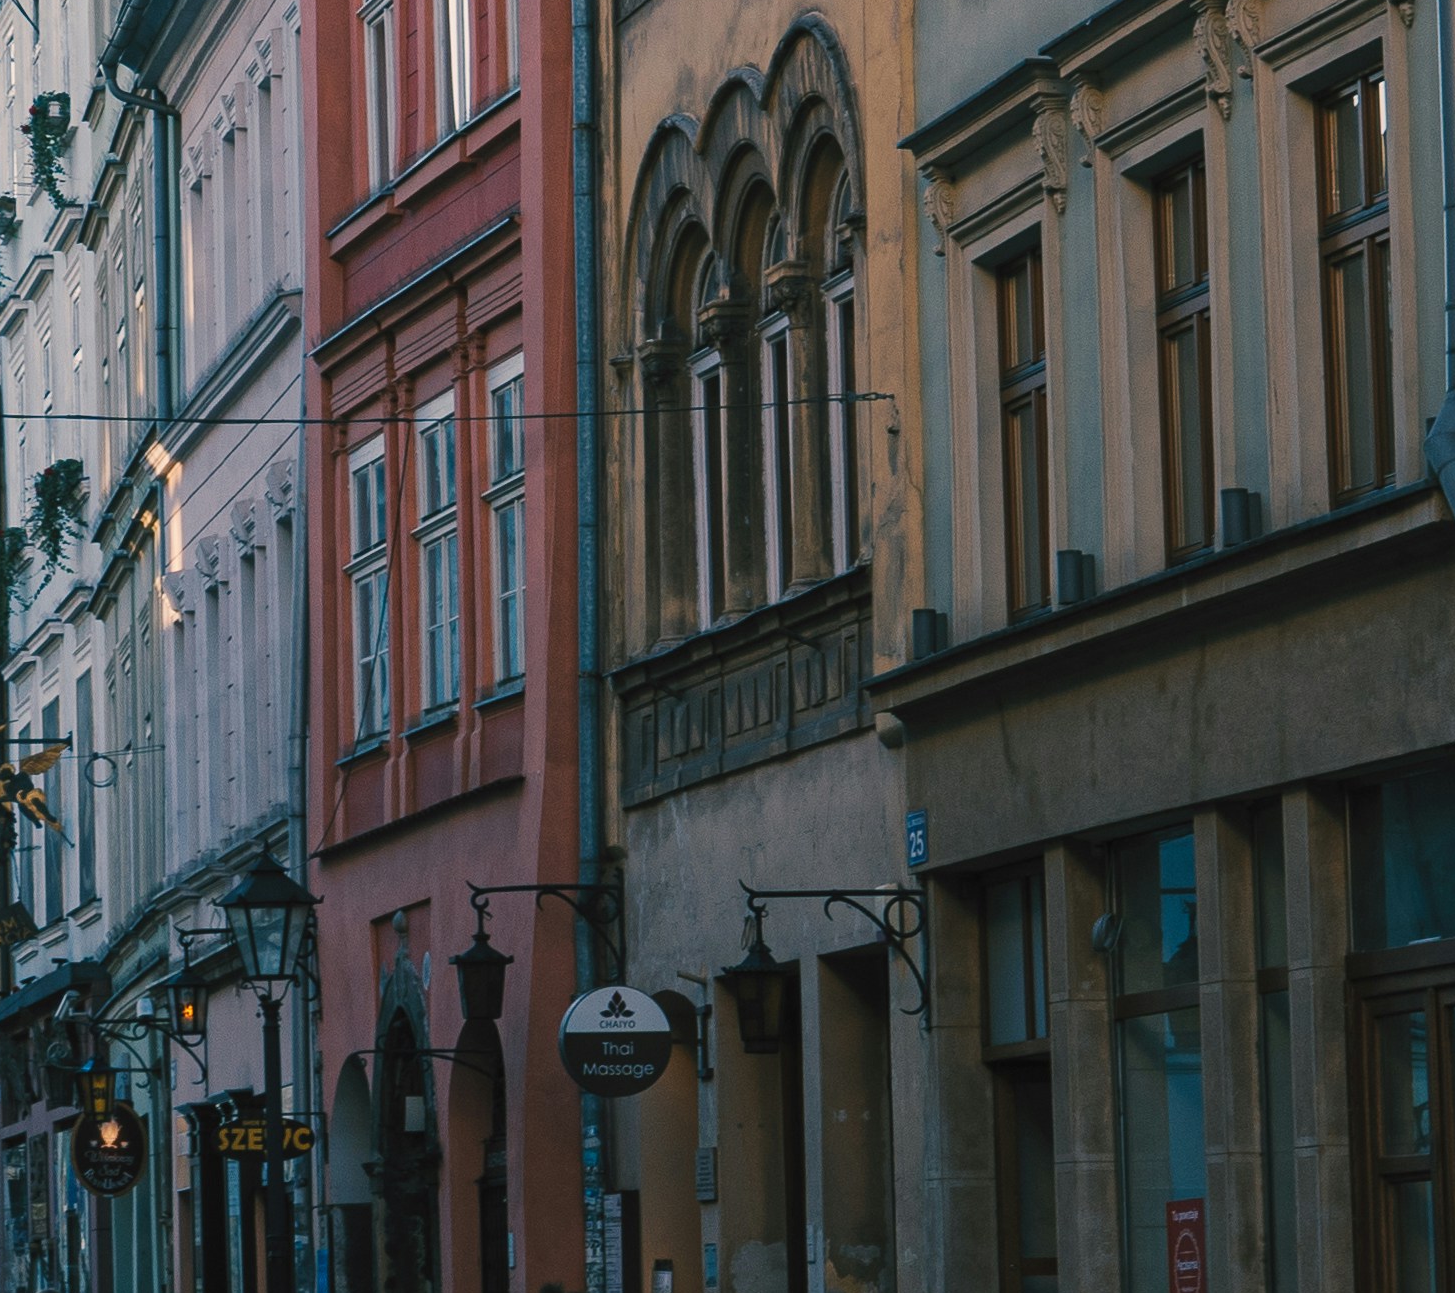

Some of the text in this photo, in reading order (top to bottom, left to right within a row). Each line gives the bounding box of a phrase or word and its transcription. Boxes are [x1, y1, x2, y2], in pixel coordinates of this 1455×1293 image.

[910, 830, 924, 857] 25
[599, 1020, 636, 1029] CHAIYO
[602, 1041, 634, 1056] Thai
[583, 1063, 655, 1078] Massage
